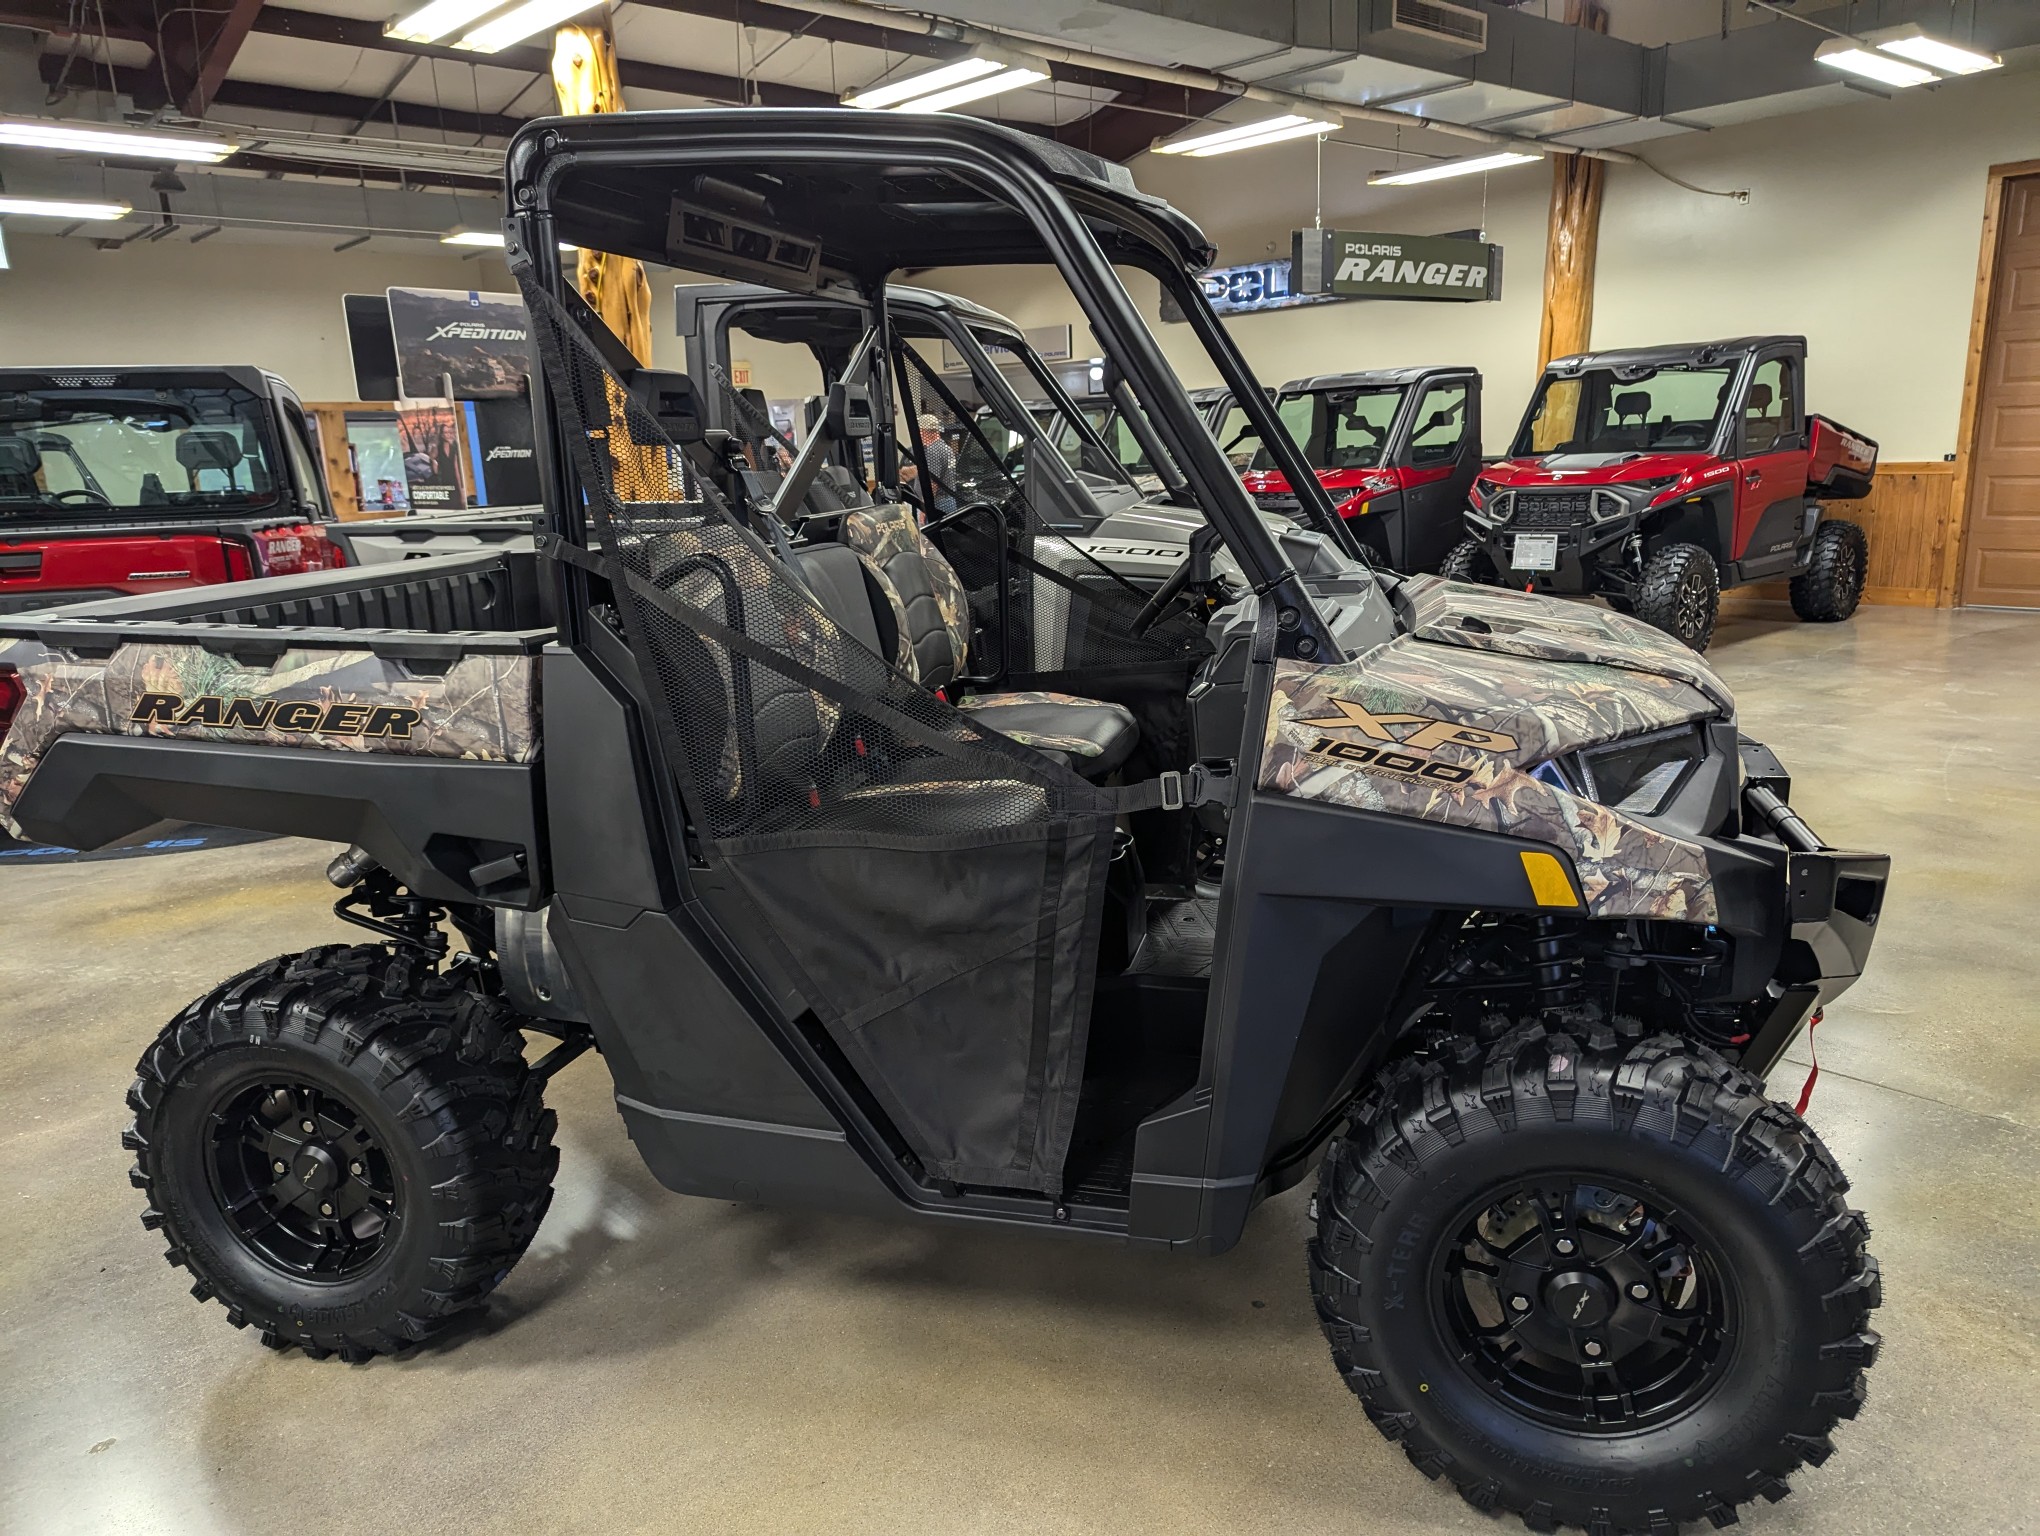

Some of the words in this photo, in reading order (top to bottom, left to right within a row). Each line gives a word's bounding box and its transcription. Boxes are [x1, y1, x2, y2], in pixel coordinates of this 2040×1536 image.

[1345, 242, 1402, 257] POLARIS
[1334, 257, 1489, 289] RANGER
[426, 321, 527, 342] XPEDITION
[734, 370, 749, 384] EXIT
[486, 446, 532, 462] XPEDITION
[1702, 465, 1730, 480] 1500
[412, 490, 450, 501] COMFORTABLE
[1518, 500, 1588, 513] POLARIS
[875, 520, 906, 535] POLARIS
[1087, 545, 1184, 558] 1500
[1769, 541, 1794, 553] POLARIS
[129, 691, 423, 740] RANGER
[1286, 697, 1520, 754] XP
[1306, 735, 1476, 785] 1000
[1303, 753, 1342, 768] DUAL
[1343, 763, 1425, 786] OVERHEAD
